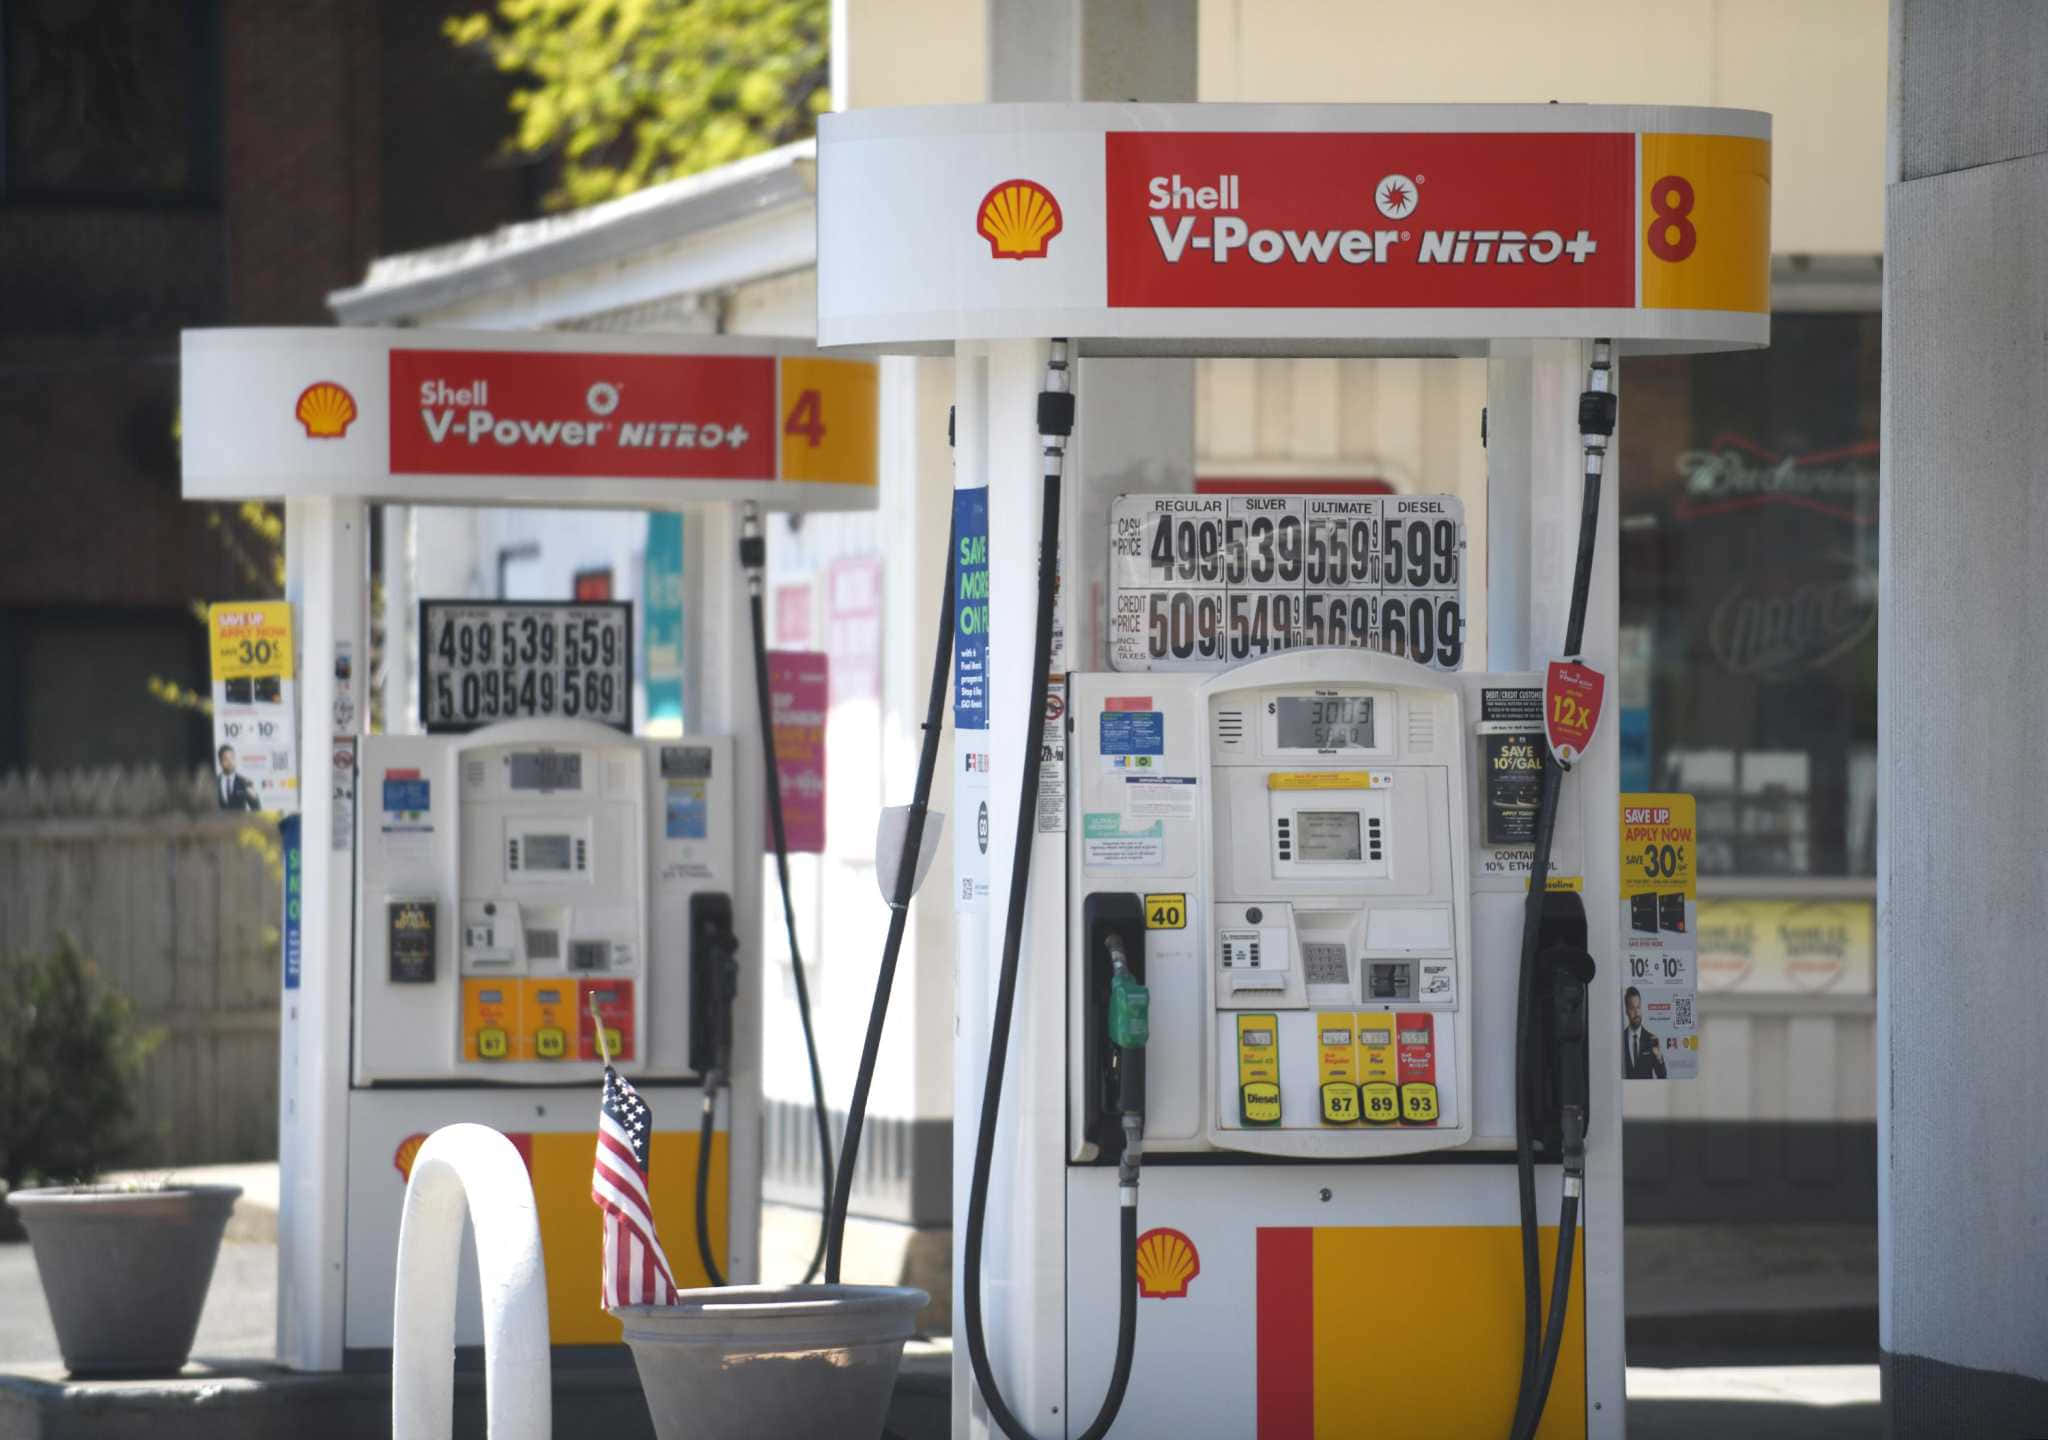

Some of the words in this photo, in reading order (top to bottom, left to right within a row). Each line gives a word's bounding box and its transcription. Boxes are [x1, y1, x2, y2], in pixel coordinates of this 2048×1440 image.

[1148, 174, 1239, 210] Shell
[1647, 175, 1697, 263] 8
[420, 380, 488, 406] Shell
[783, 389, 827, 448] 4
[1155, 500, 1222, 512] REGULAR
[1246, 498, 1287, 510] SILVER
[1312, 501, 1373, 514] ULTIMATE
[1398, 501, 1445, 513] DIESEL
[1117, 517, 1141, 537] CASH
[1117, 538, 1142, 556] PRICE
[1117, 595, 1147, 613] CREDIT
[1117, 614, 1141, 633] PRICE
[438, 620, 495, 668] 499
[502, 617, 555, 667] 539
[564, 619, 615, 667] 559
[437, 672, 499, 719] 509
[503, 669, 554, 716] 549
[563, 670, 614, 716] 569
[1500, 745, 1534, 758] SAVE
[1624, 807, 1651, 825] SAVE
[1625, 827, 1657, 842] APPLY
[1494, 850, 1536, 861] CONTAI
[1151, 906, 1180, 926] 40
[1247, 1093, 1279, 1104] Diesel
[1331, 1096, 1353, 1112] 87
[1370, 1096, 1393, 1112] 89
[1409, 1096, 1432, 1112] 93
